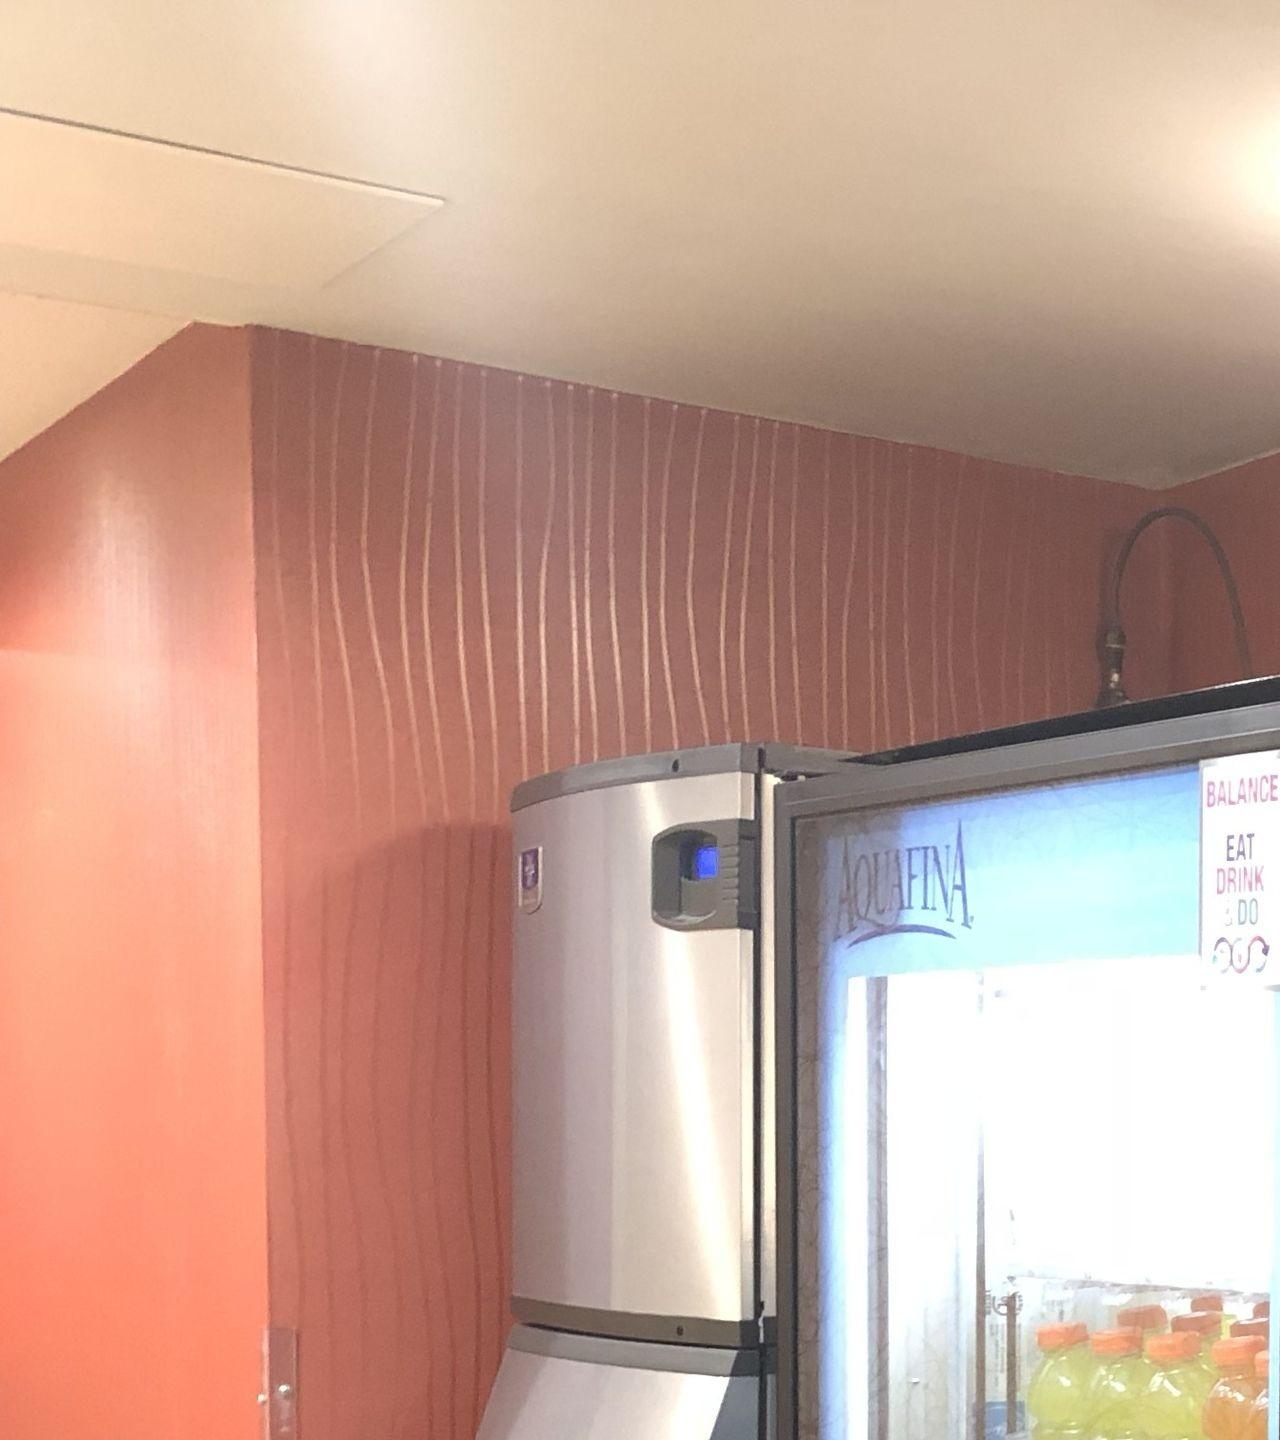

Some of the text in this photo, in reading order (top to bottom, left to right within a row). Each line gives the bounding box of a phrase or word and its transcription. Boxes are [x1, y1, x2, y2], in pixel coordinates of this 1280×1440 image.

[1207, 774, 1279, 808] BALANCE
[1226, 833, 1255, 862] EAT
[833, 818, 973, 942] AQUAFINA
[1216, 866, 1264, 895] DRINK
